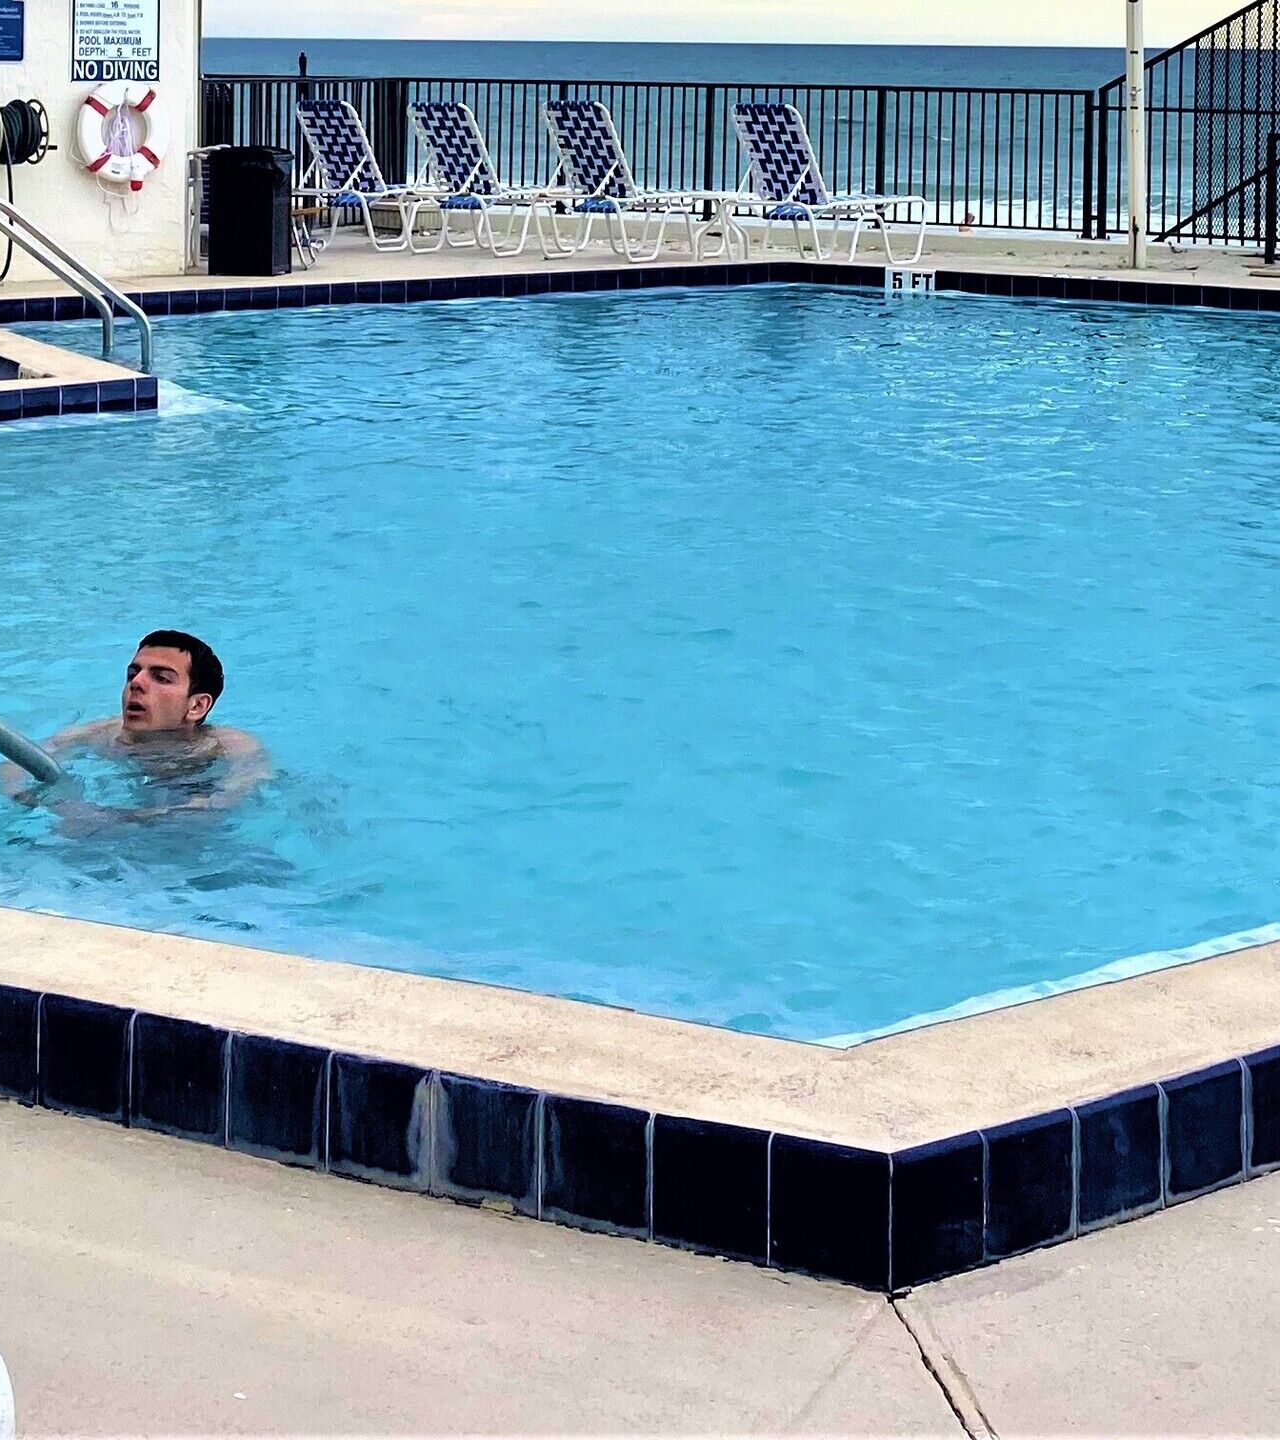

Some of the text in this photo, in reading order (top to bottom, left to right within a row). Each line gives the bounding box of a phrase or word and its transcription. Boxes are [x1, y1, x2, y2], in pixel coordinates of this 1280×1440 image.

[111, 0, 119, 9] 16
[78, 35, 142, 45] POOL MAXIMUM
[78, 47, 152, 57] DEPTH: 5 FEET
[73, 60, 158, 80] NO DIVING
[911, 272, 933, 291] FT
